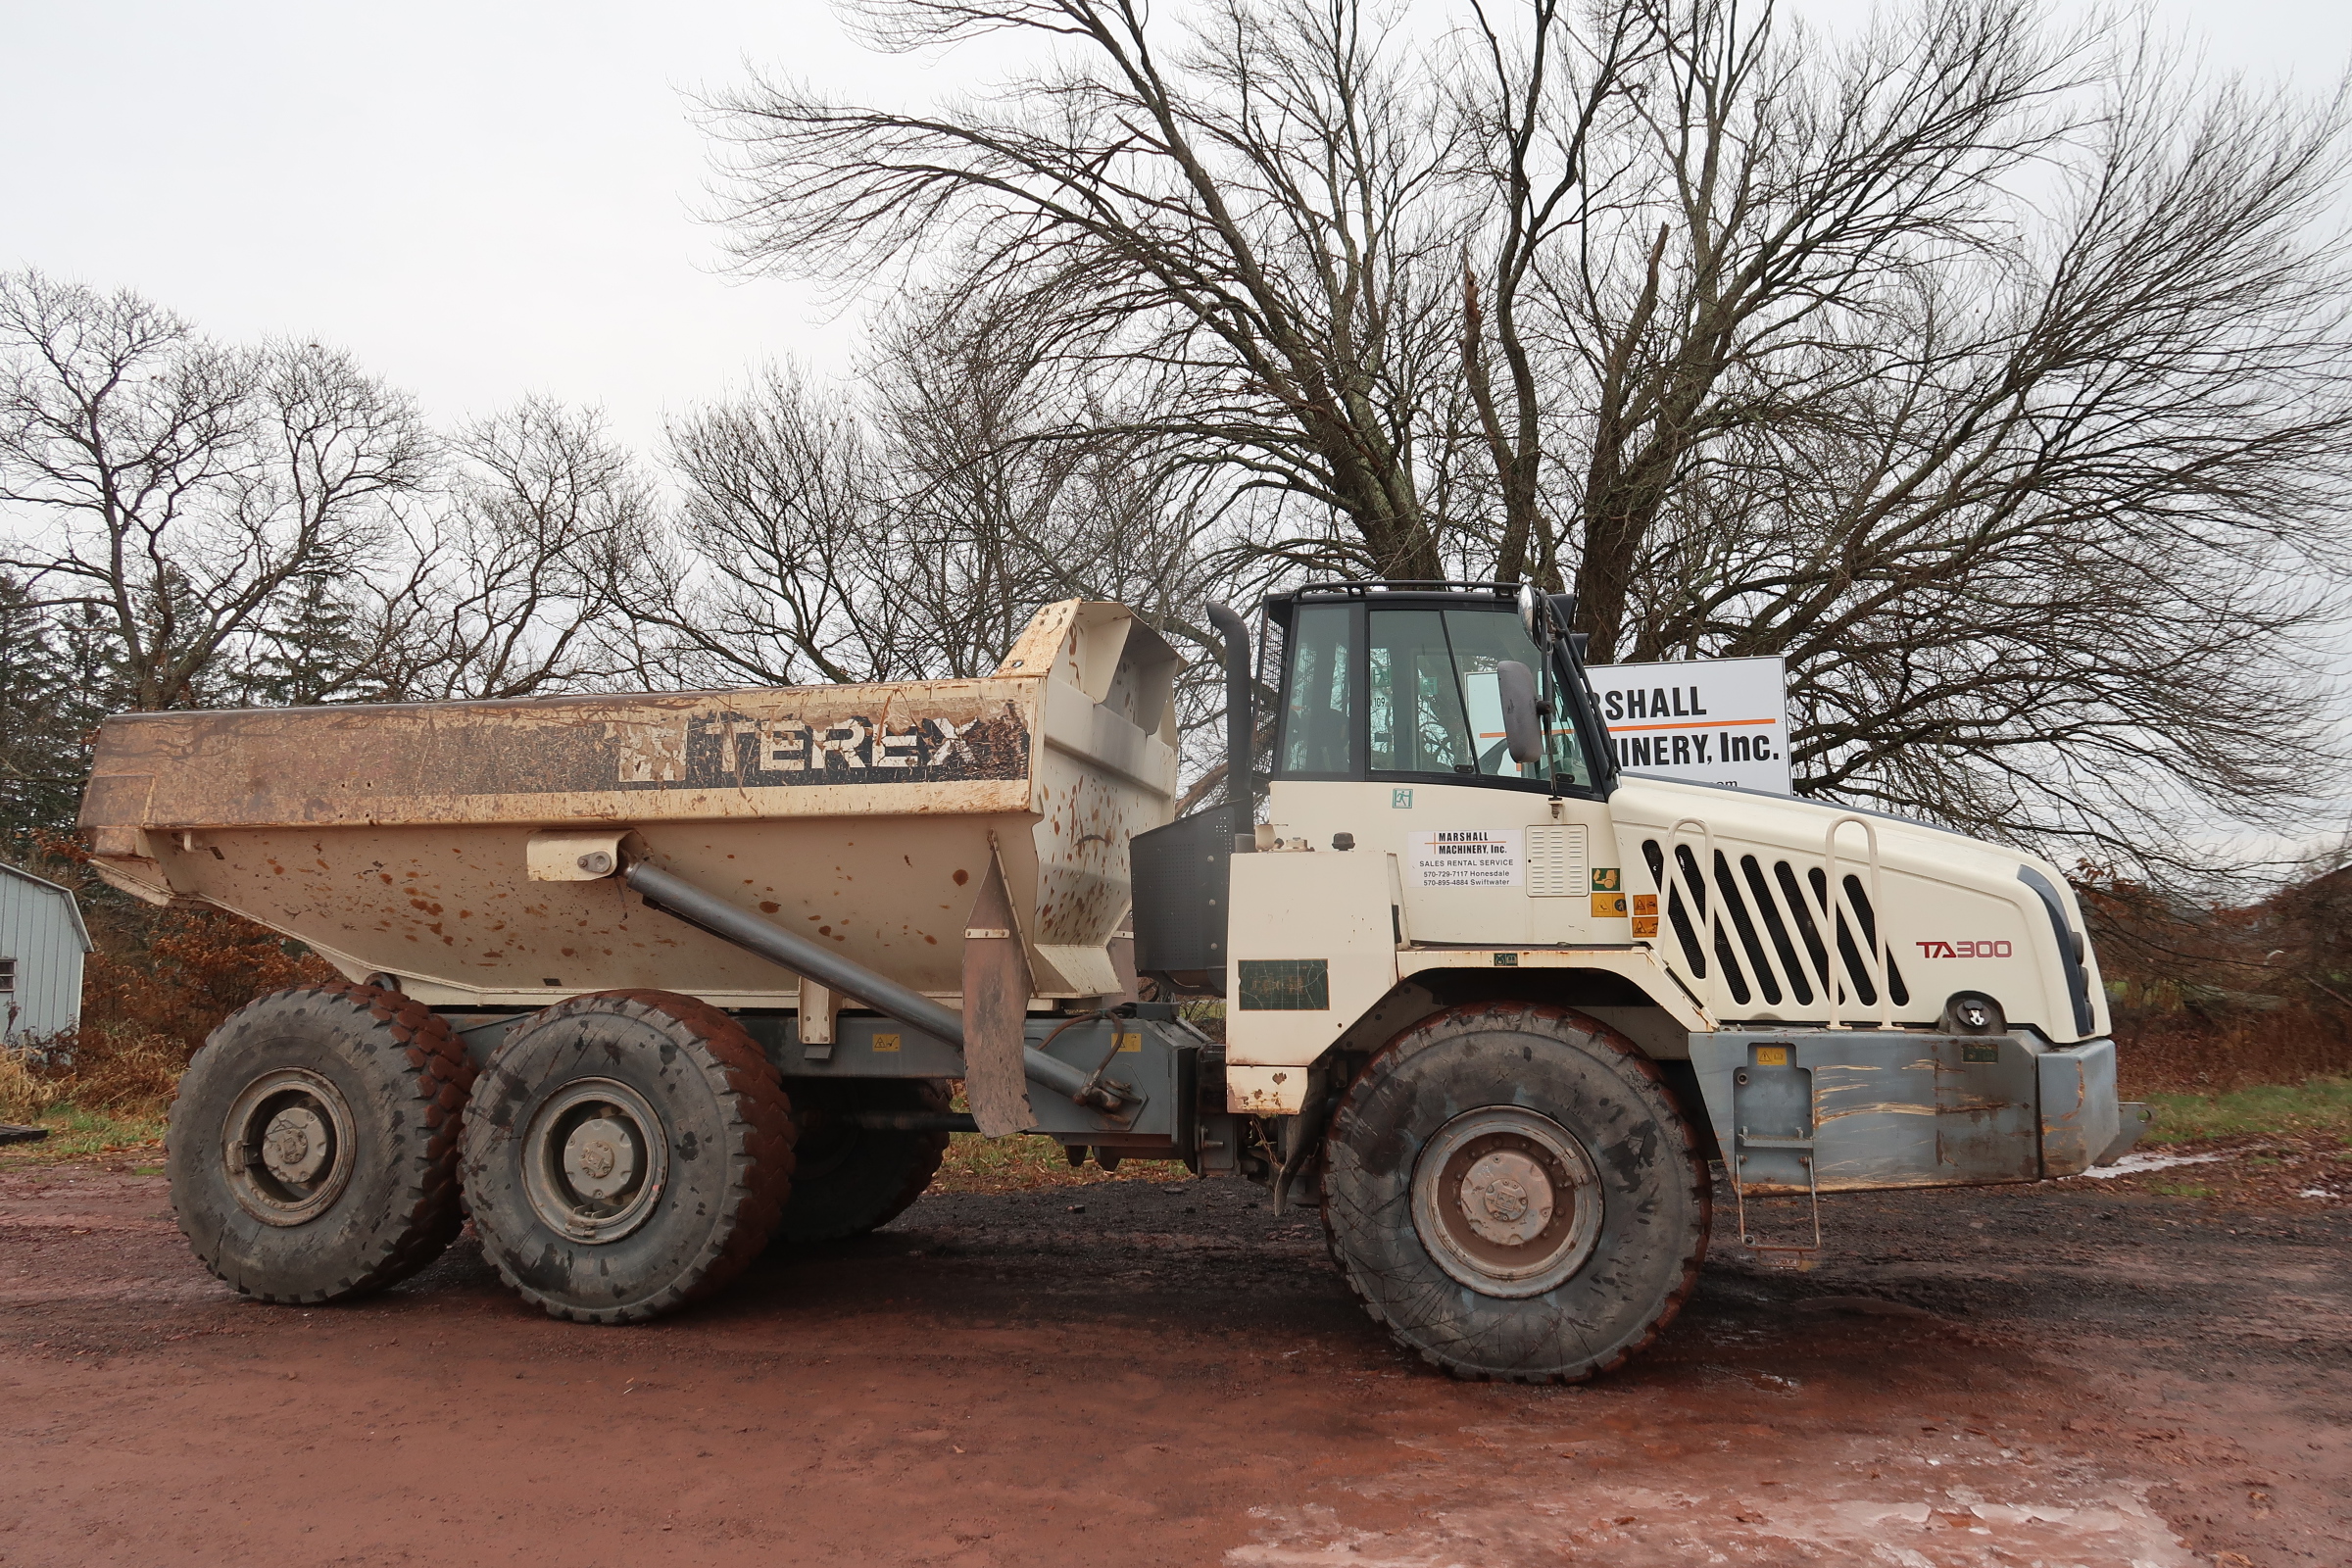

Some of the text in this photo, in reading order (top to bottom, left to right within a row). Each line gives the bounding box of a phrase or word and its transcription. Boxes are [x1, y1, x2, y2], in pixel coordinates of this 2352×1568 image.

[705, 715, 978, 771] TEREX
[1720, 732, 1779, 762] Inc.
[1439, 832, 1489, 842] MARSHALL
[1439, 844, 1507, 855] MACHINERY, Inc.
[1916, 941, 2012, 958] TA300
